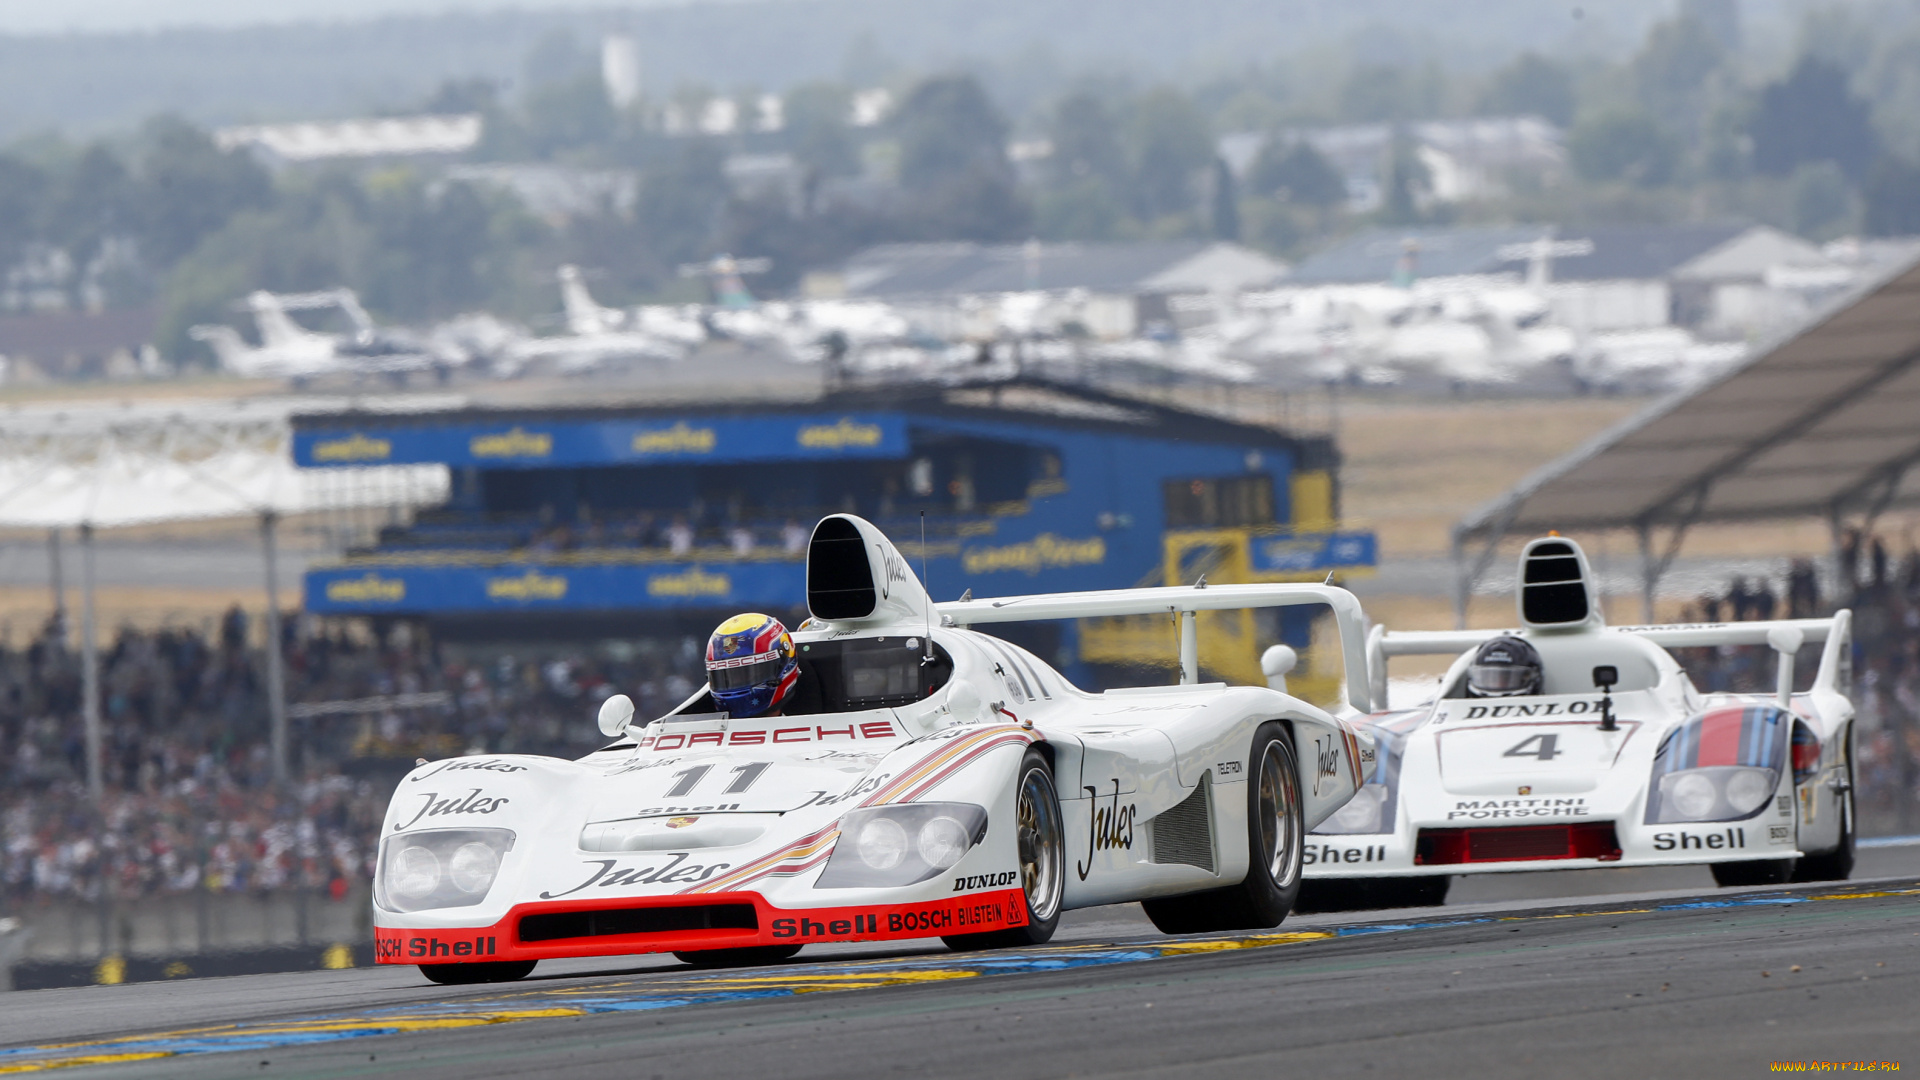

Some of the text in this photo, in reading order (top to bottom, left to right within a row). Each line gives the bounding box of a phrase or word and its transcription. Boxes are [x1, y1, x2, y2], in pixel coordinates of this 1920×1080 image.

[875, 541, 907, 600] Jules
[706, 652, 777, 670] PORSCHE
[640, 721, 896, 751] PORSCHE
[1502, 734, 1563, 761] 4
[411, 759, 528, 782] Jules
[1314, 734, 1338, 797] Jules
[662, 761, 775, 799] 11
[394, 788, 509, 832] Jules
[638, 803, 741, 816] Shell
[1448, 807, 1590, 820] PORSCHE
[1455, 798, 1585, 810] MARTINI
[1078, 778, 1136, 881] Jules
[1653, 827, 1745, 851] Shell
[1303, 844, 1386, 865] Shell
[539, 853, 731, 899] Jules
[953, 871, 1017, 892] DUNLOP
[772, 914, 877, 938] Shell
[888, 908, 952, 932] BOSCH
[958, 903, 1003, 926] BILSTEIN
[408, 936, 496, 957] Shell
